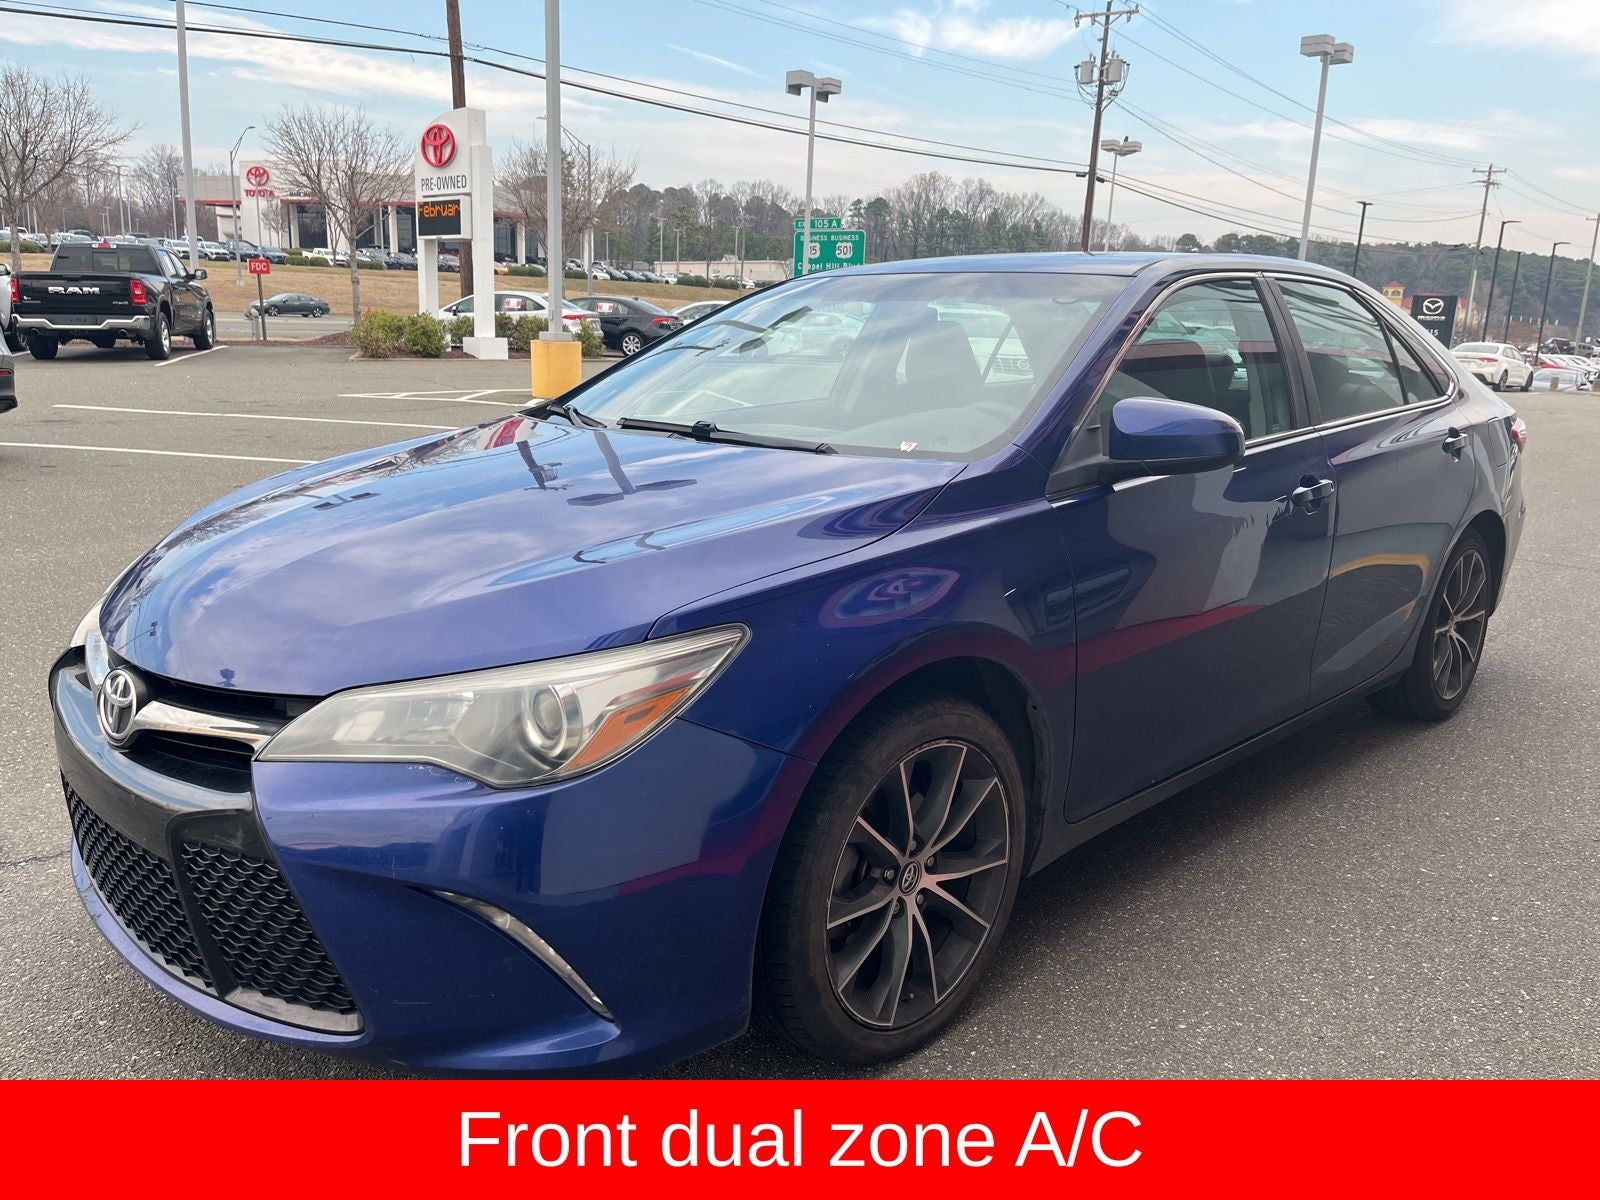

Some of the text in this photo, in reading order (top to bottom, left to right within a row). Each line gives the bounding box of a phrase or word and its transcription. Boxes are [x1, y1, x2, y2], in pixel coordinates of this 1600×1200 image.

[421, 174, 467, 191] PRE-OWNED
[814, 219, 829, 228] 105
[831, 219, 838, 228] A
[809, 245, 818, 255] 15
[837, 245, 852, 255] 501
[250, 262, 268, 271] FDC
[48, 286, 101, 295] RAM
